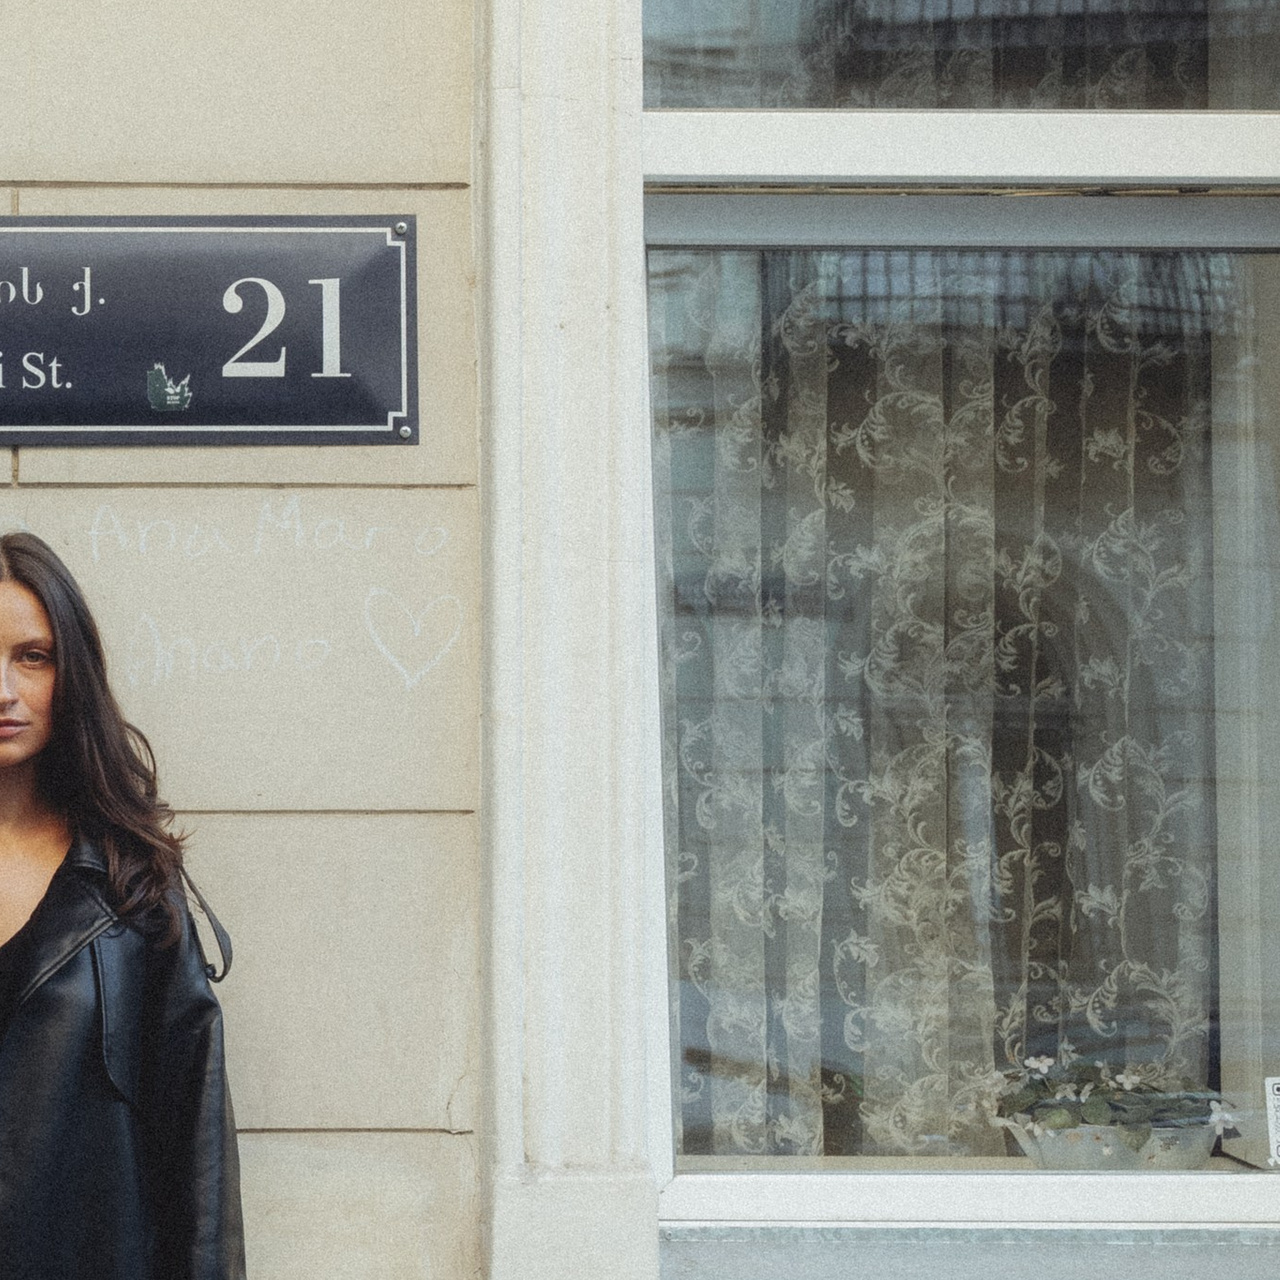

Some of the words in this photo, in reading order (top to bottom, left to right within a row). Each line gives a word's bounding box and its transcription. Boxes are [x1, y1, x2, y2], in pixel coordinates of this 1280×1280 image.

[71, 266, 106, 316] ქ.
[222, 276, 352, 378] 21
[21, 351, 73, 390] St.
[88, 503, 233, 562] Ana
